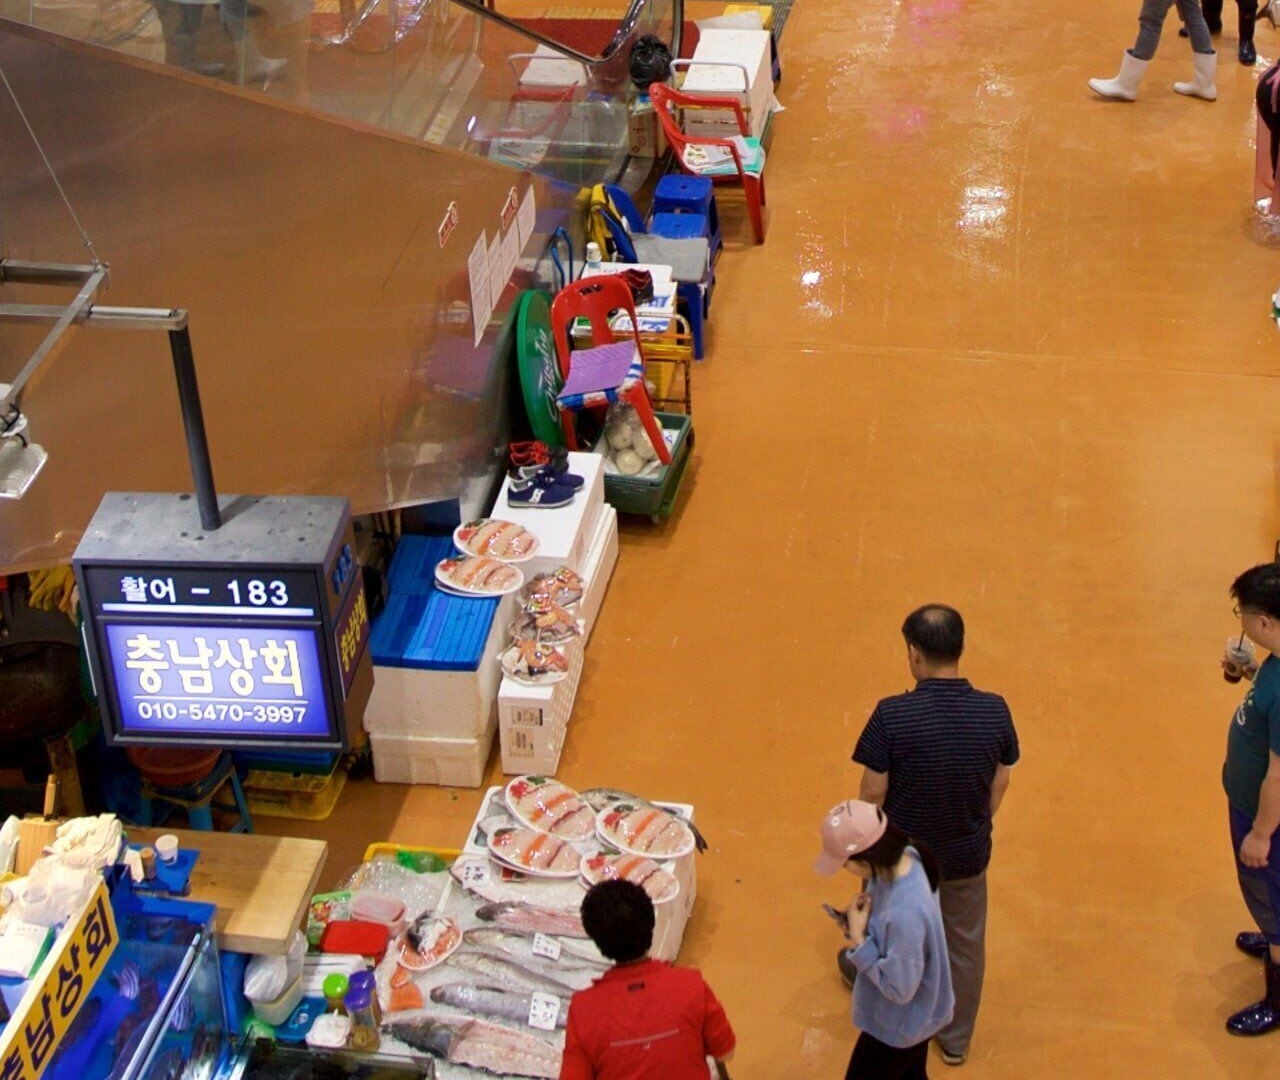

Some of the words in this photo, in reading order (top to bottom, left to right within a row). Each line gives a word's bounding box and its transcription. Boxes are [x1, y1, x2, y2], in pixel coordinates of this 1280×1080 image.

[121, 575, 177, 604] 활어
[227, 579, 290, 607] 183
[125, 633, 304, 698] 충남상회
[137, 701, 307, 725] 010-5470-3997
